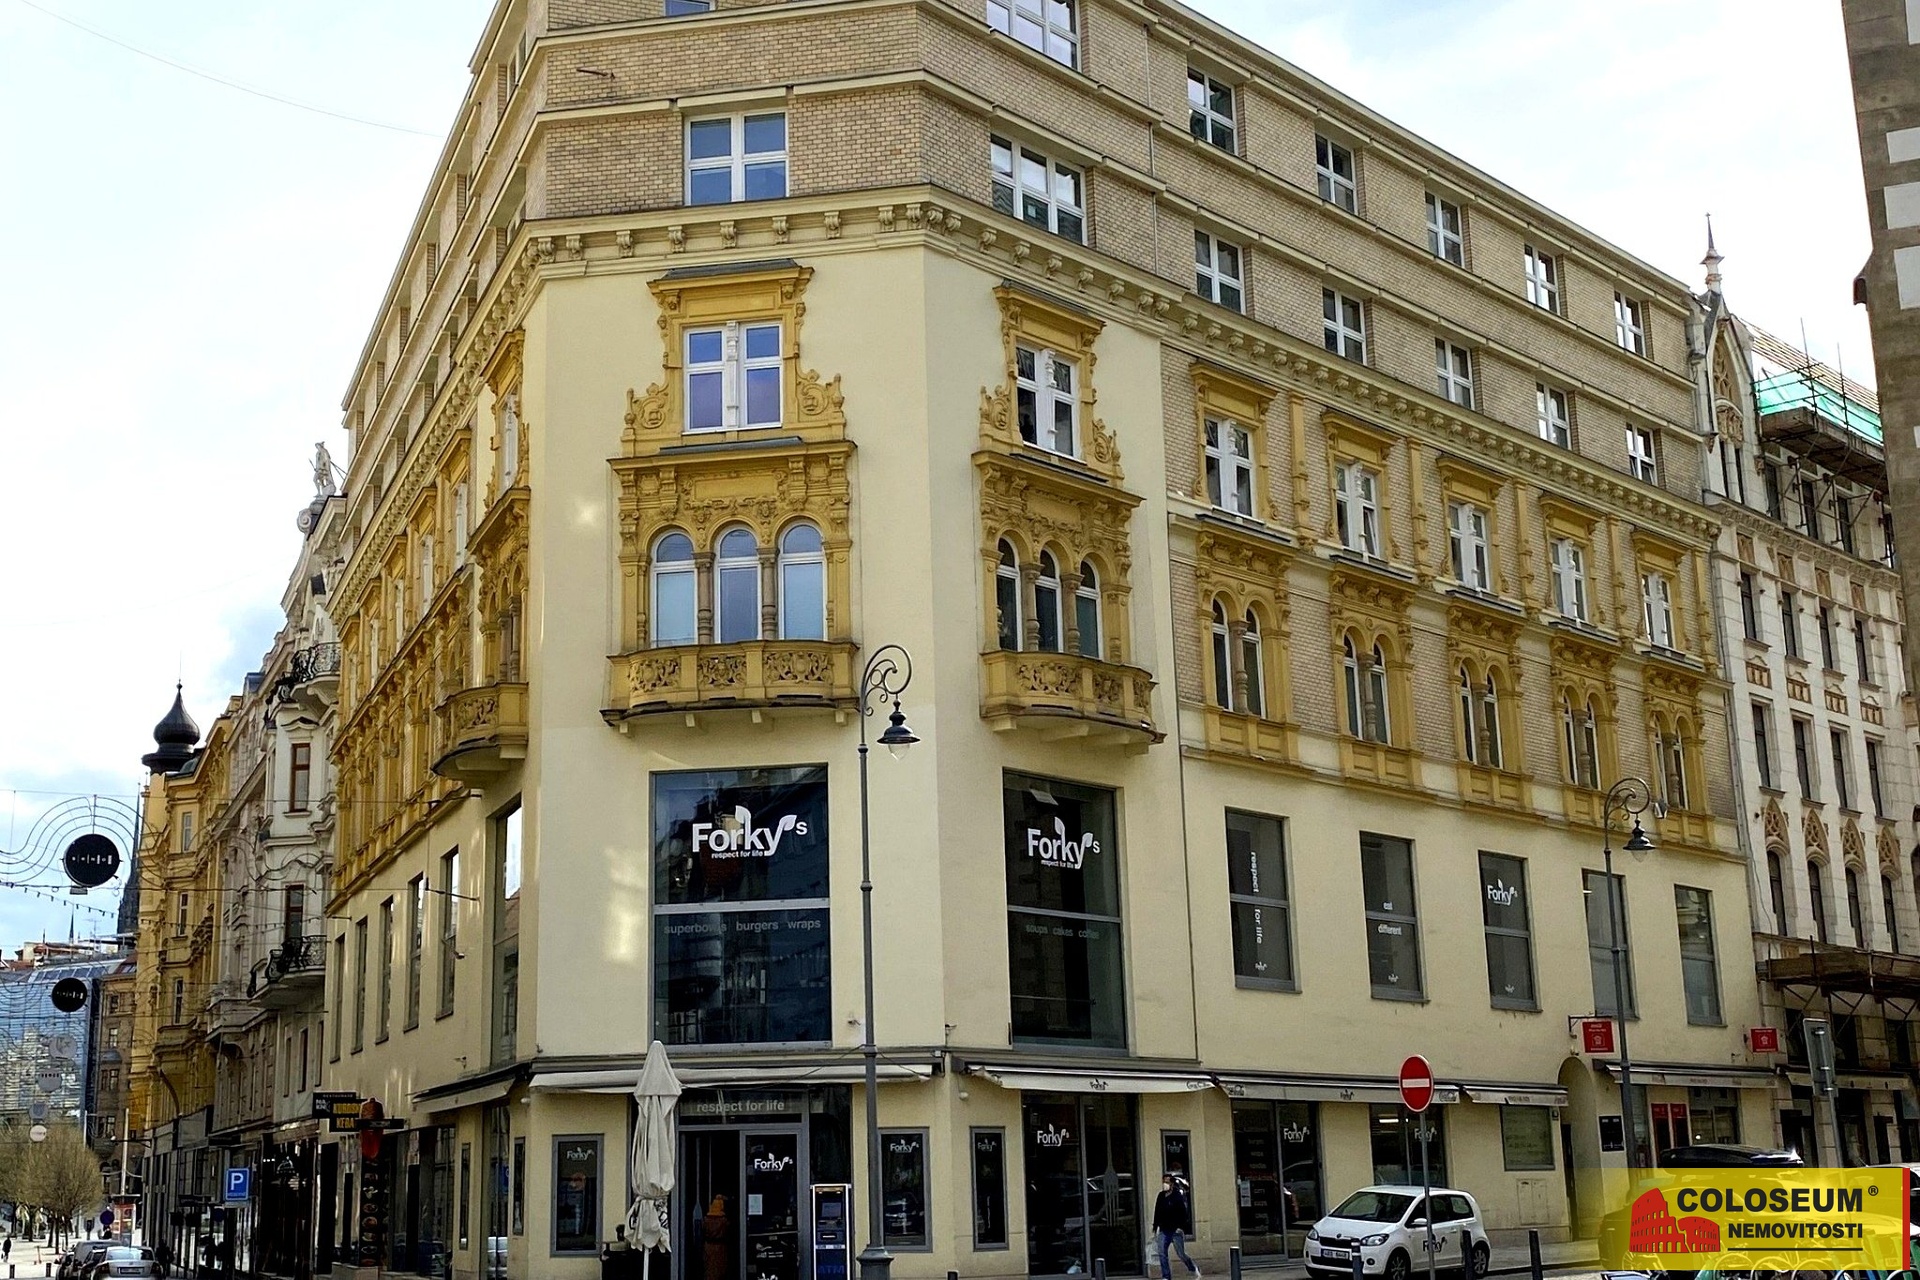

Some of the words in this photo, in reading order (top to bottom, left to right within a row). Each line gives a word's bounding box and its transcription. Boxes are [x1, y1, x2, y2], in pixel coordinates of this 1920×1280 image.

[711, 851, 739, 859] respect
[751, 850, 764, 858] life
[1250, 852, 1260, 893] respect
[1254, 908, 1262, 925] for
[735, 921, 779, 933] burgers
[787, 919, 821, 931] wraps
[697, 1100, 743, 1114] respect
[746, 1100, 763, 1112] for
[766, 1100, 785, 1111] life
[230, 1172, 244, 1191] P
